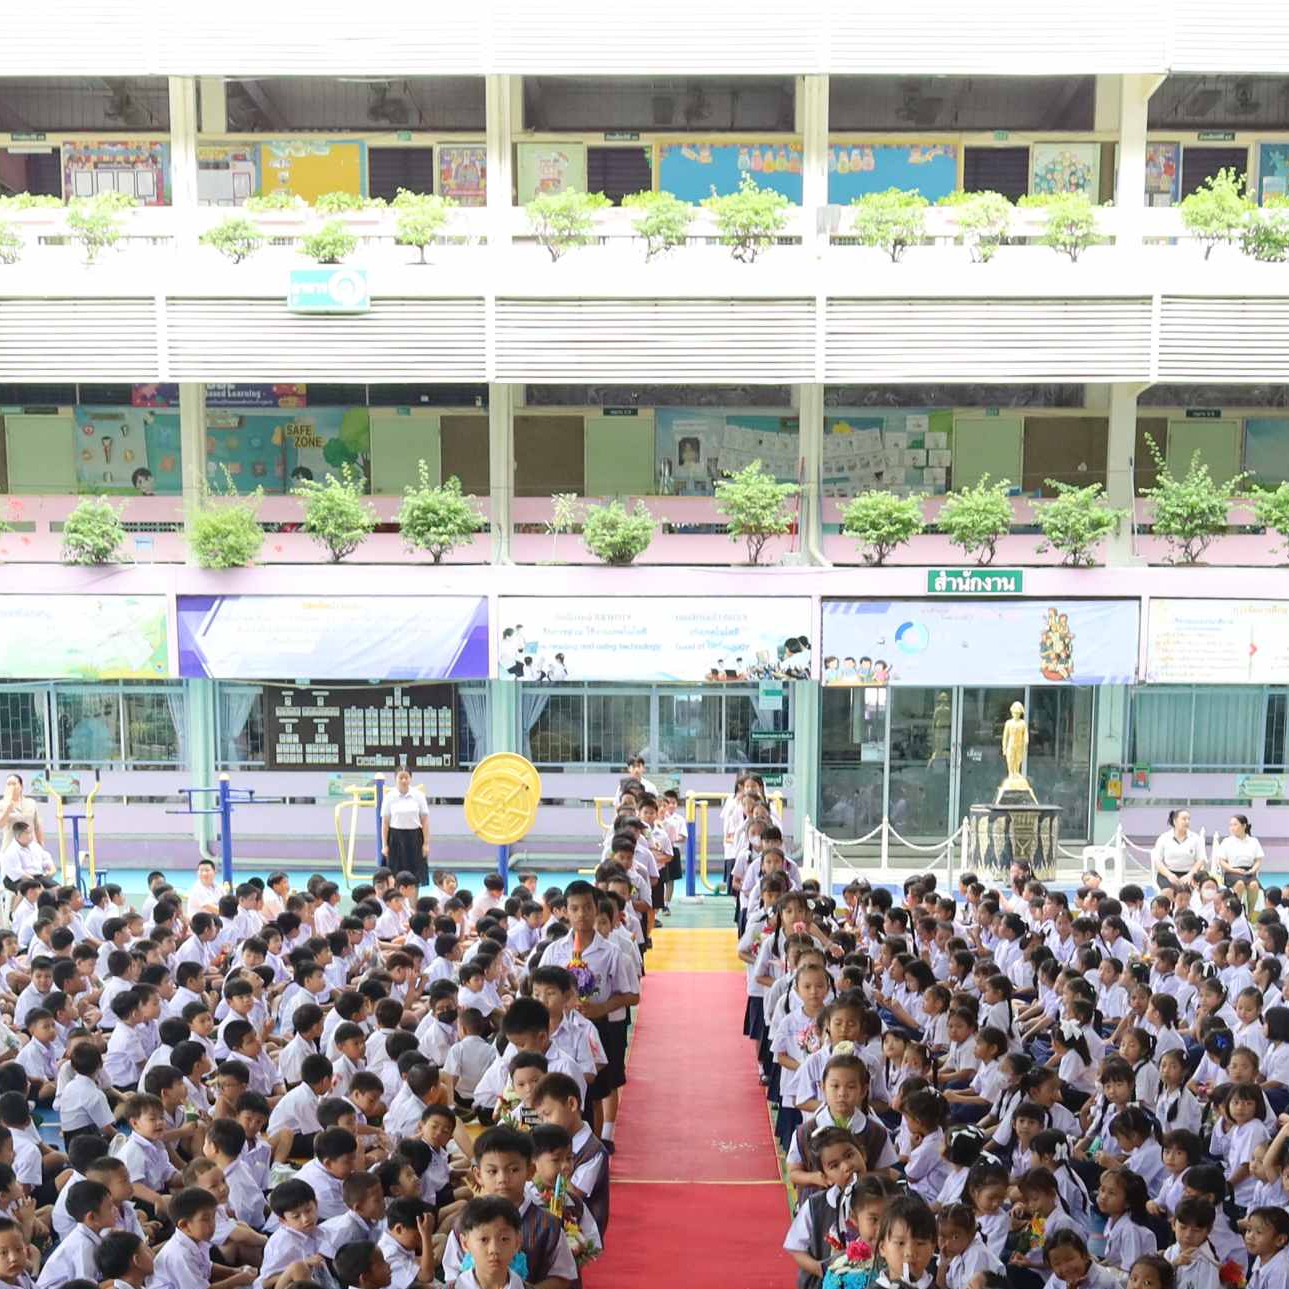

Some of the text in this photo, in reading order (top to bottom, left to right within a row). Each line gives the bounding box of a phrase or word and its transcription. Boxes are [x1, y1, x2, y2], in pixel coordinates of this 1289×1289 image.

[286, 424, 312, 436] SAFE
[294, 435, 323, 449] ZONE
[934, 569, 1015, 592] สำนักงาน
